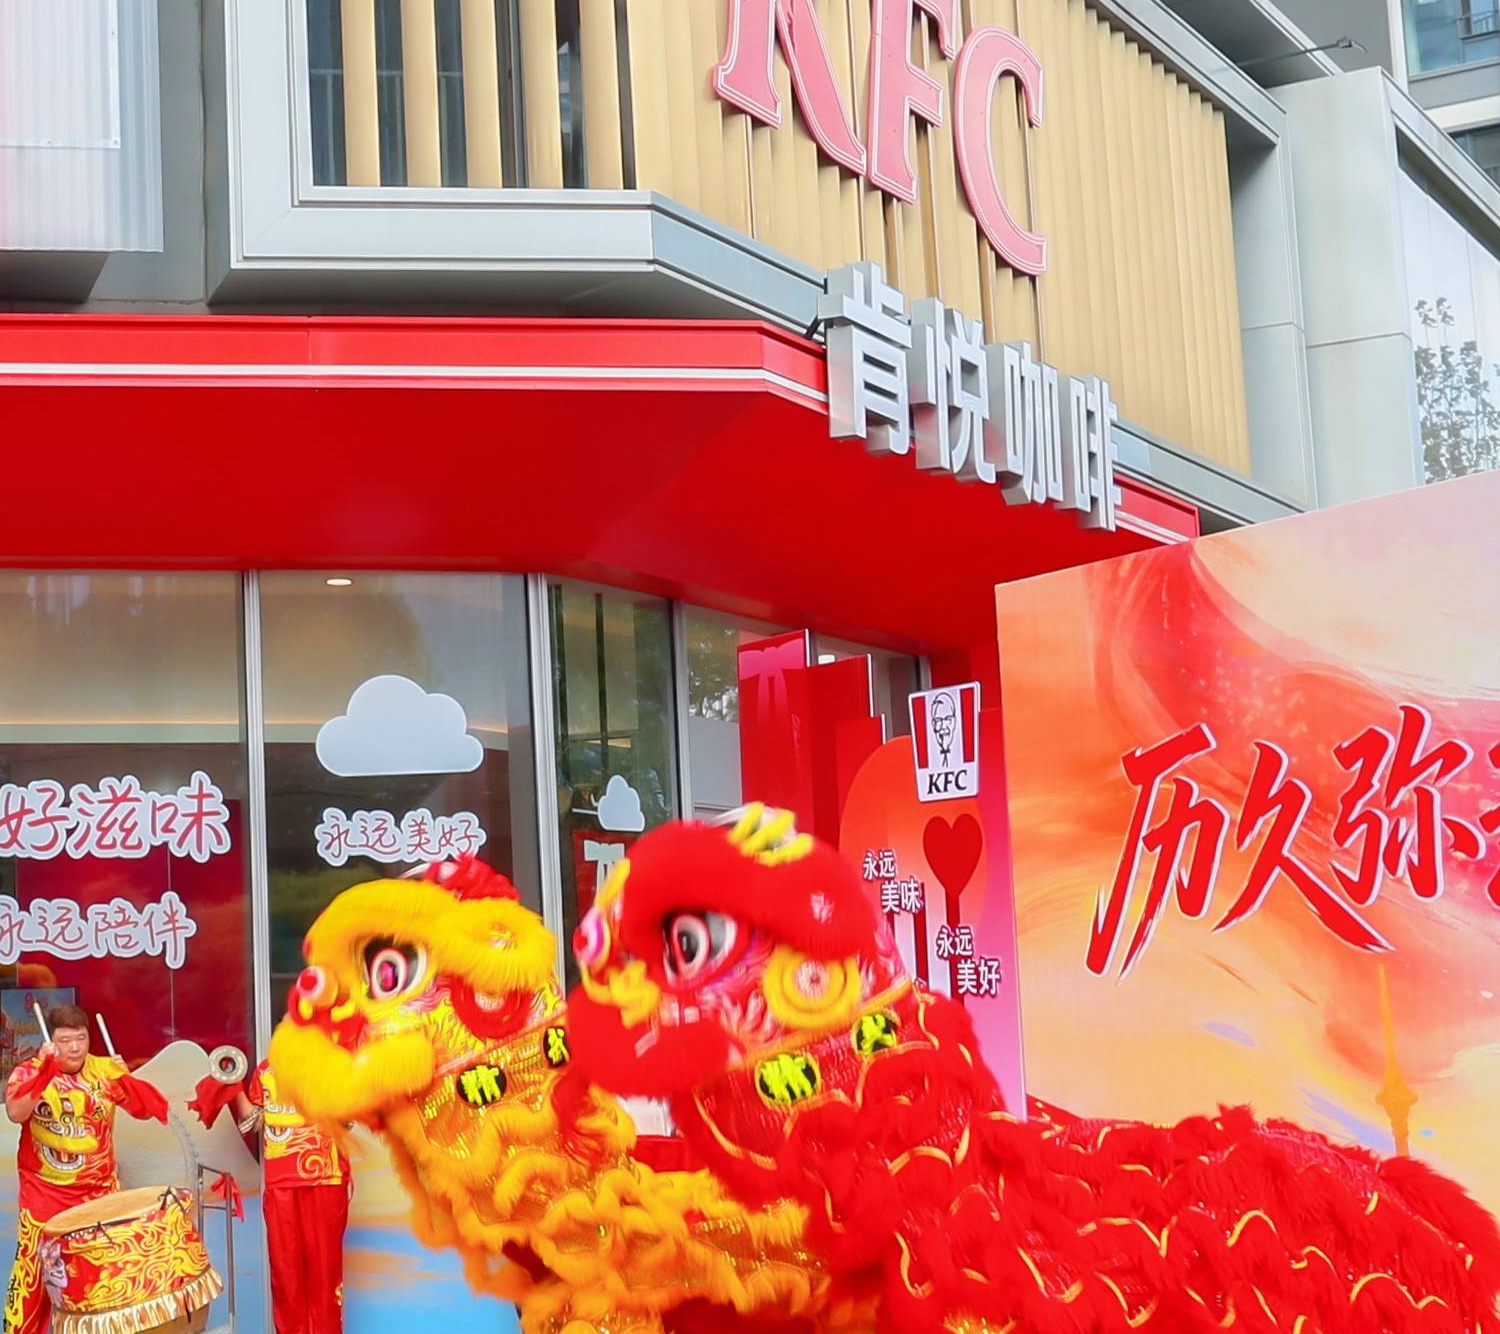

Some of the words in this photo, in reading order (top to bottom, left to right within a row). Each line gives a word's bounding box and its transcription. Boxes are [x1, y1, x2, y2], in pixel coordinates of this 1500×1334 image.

[816, 260, 1122, 533] 肯悦咖啡
[926, 768, 968, 795] KFC
[319, 813, 482, 863] 永远美好
[863, 850, 897, 880] 永远
[881, 878, 922, 914] 美味
[936, 926, 975, 959] 永远
[956, 959, 1002, 996] 美好
